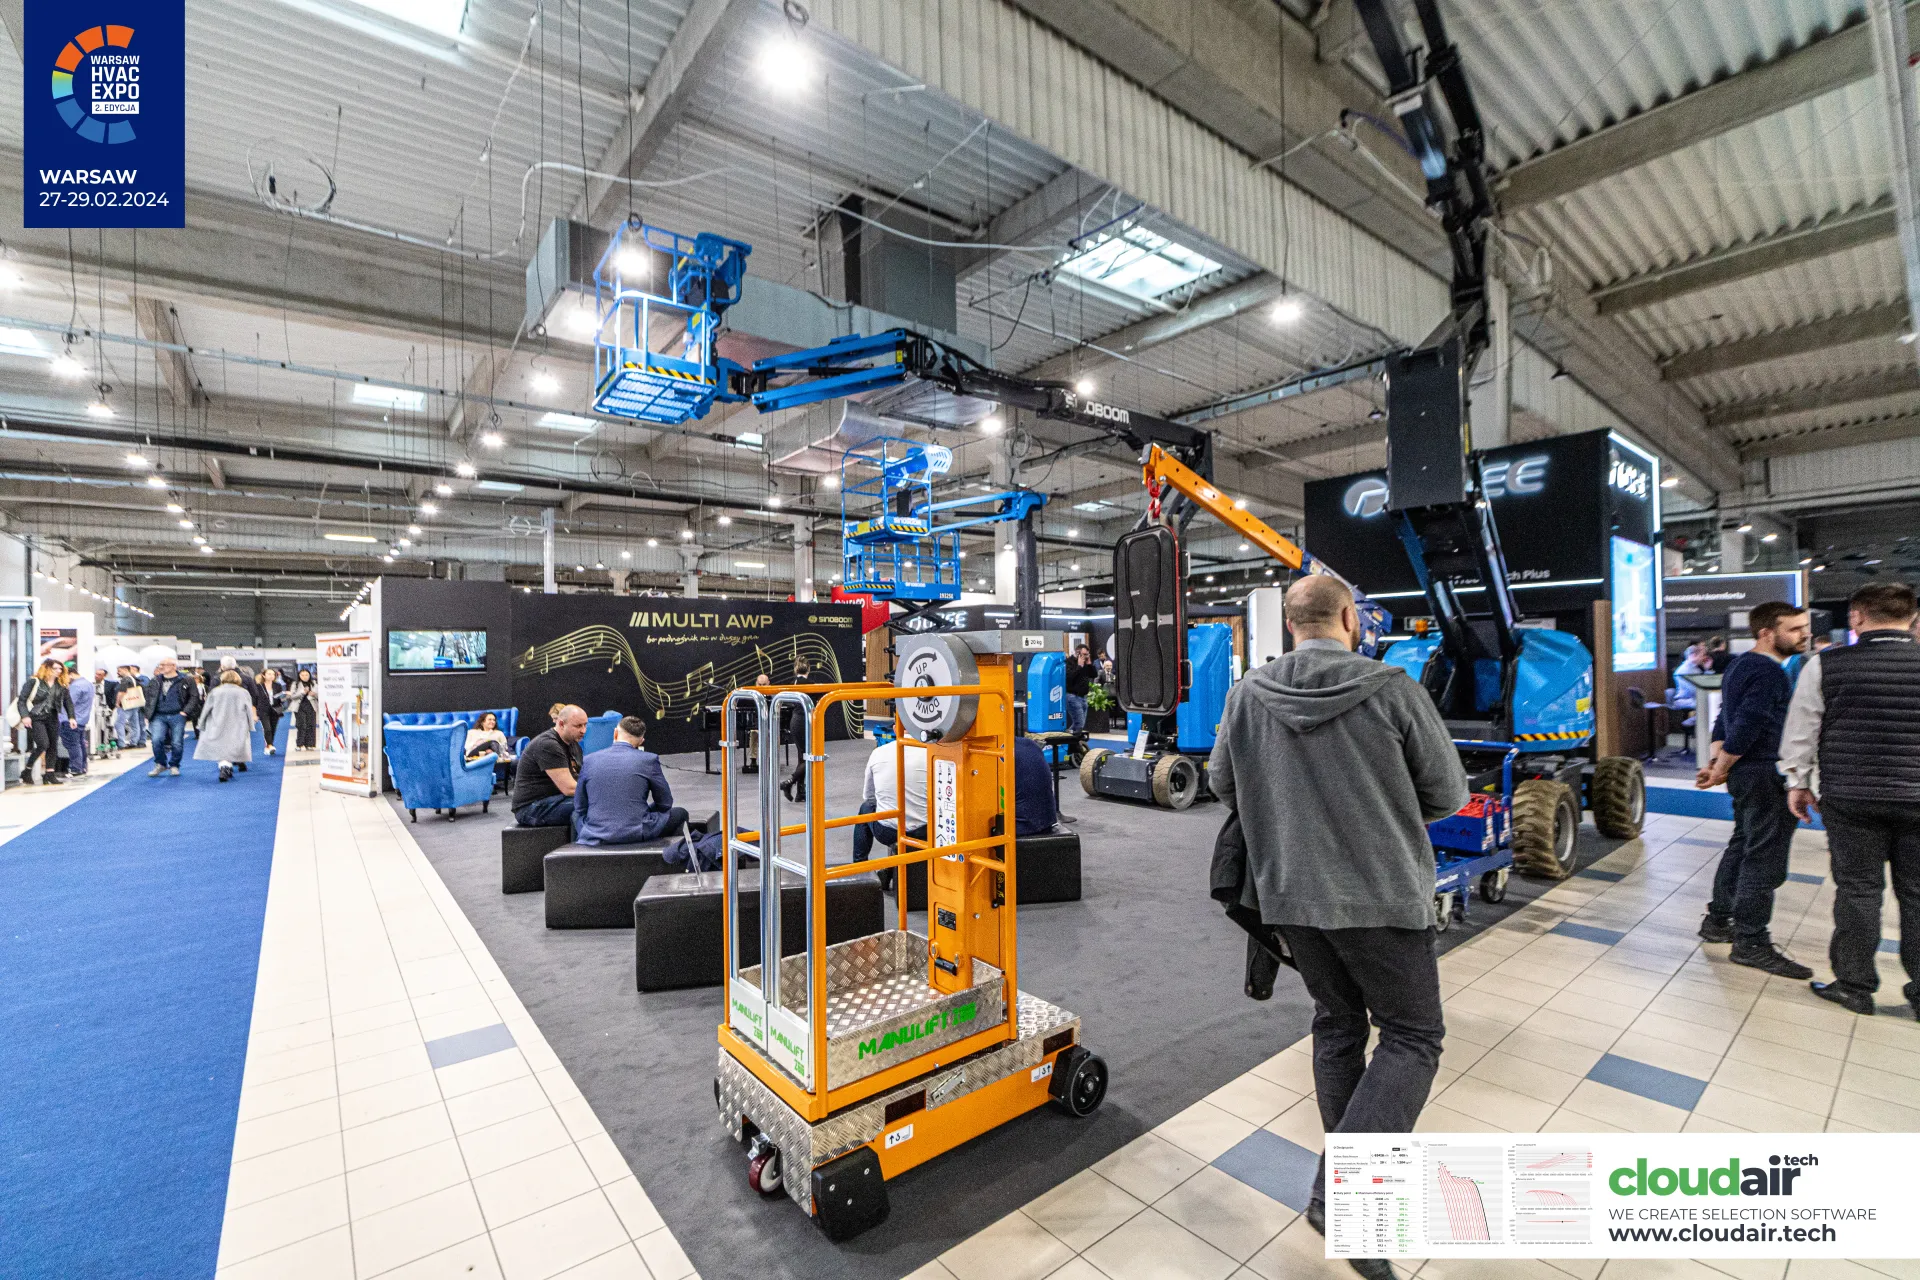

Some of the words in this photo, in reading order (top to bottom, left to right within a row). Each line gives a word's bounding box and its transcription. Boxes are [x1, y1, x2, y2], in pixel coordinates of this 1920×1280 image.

[652, 612, 719, 628] MULTI
[725, 614, 773, 629] AWP
[915, 662, 928, 675] UP
[732, 997, 763, 1028] MANULIFT
[770, 1025, 804, 1061] MANULIFT
[858, 1010, 950, 1061] MANULIFT
